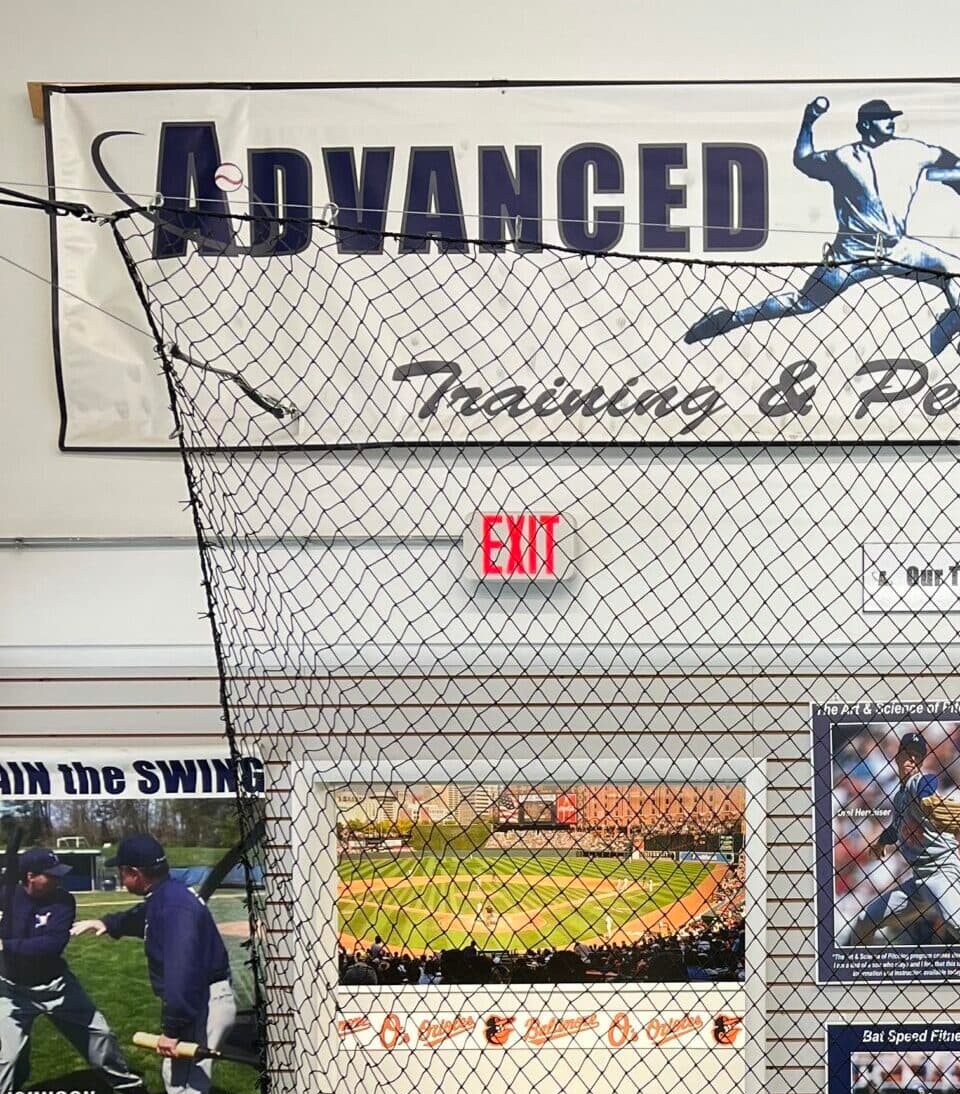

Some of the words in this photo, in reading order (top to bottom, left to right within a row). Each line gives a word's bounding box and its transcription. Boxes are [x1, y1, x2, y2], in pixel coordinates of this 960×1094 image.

[152, 121, 770, 260] ADVANCED
[392, 360, 726, 436] Training
[758, 360, 817, 417] &
[482, 515, 560, 575] EXIT
[906, 565, 943, 587] Our
[927, 702, 940, 714] of
[57, 762, 126, 794] the
[133, 757, 265, 795] SWING
[862, 1030, 885, 1042] Bat
[887, 1029, 928, 1045] Speed
